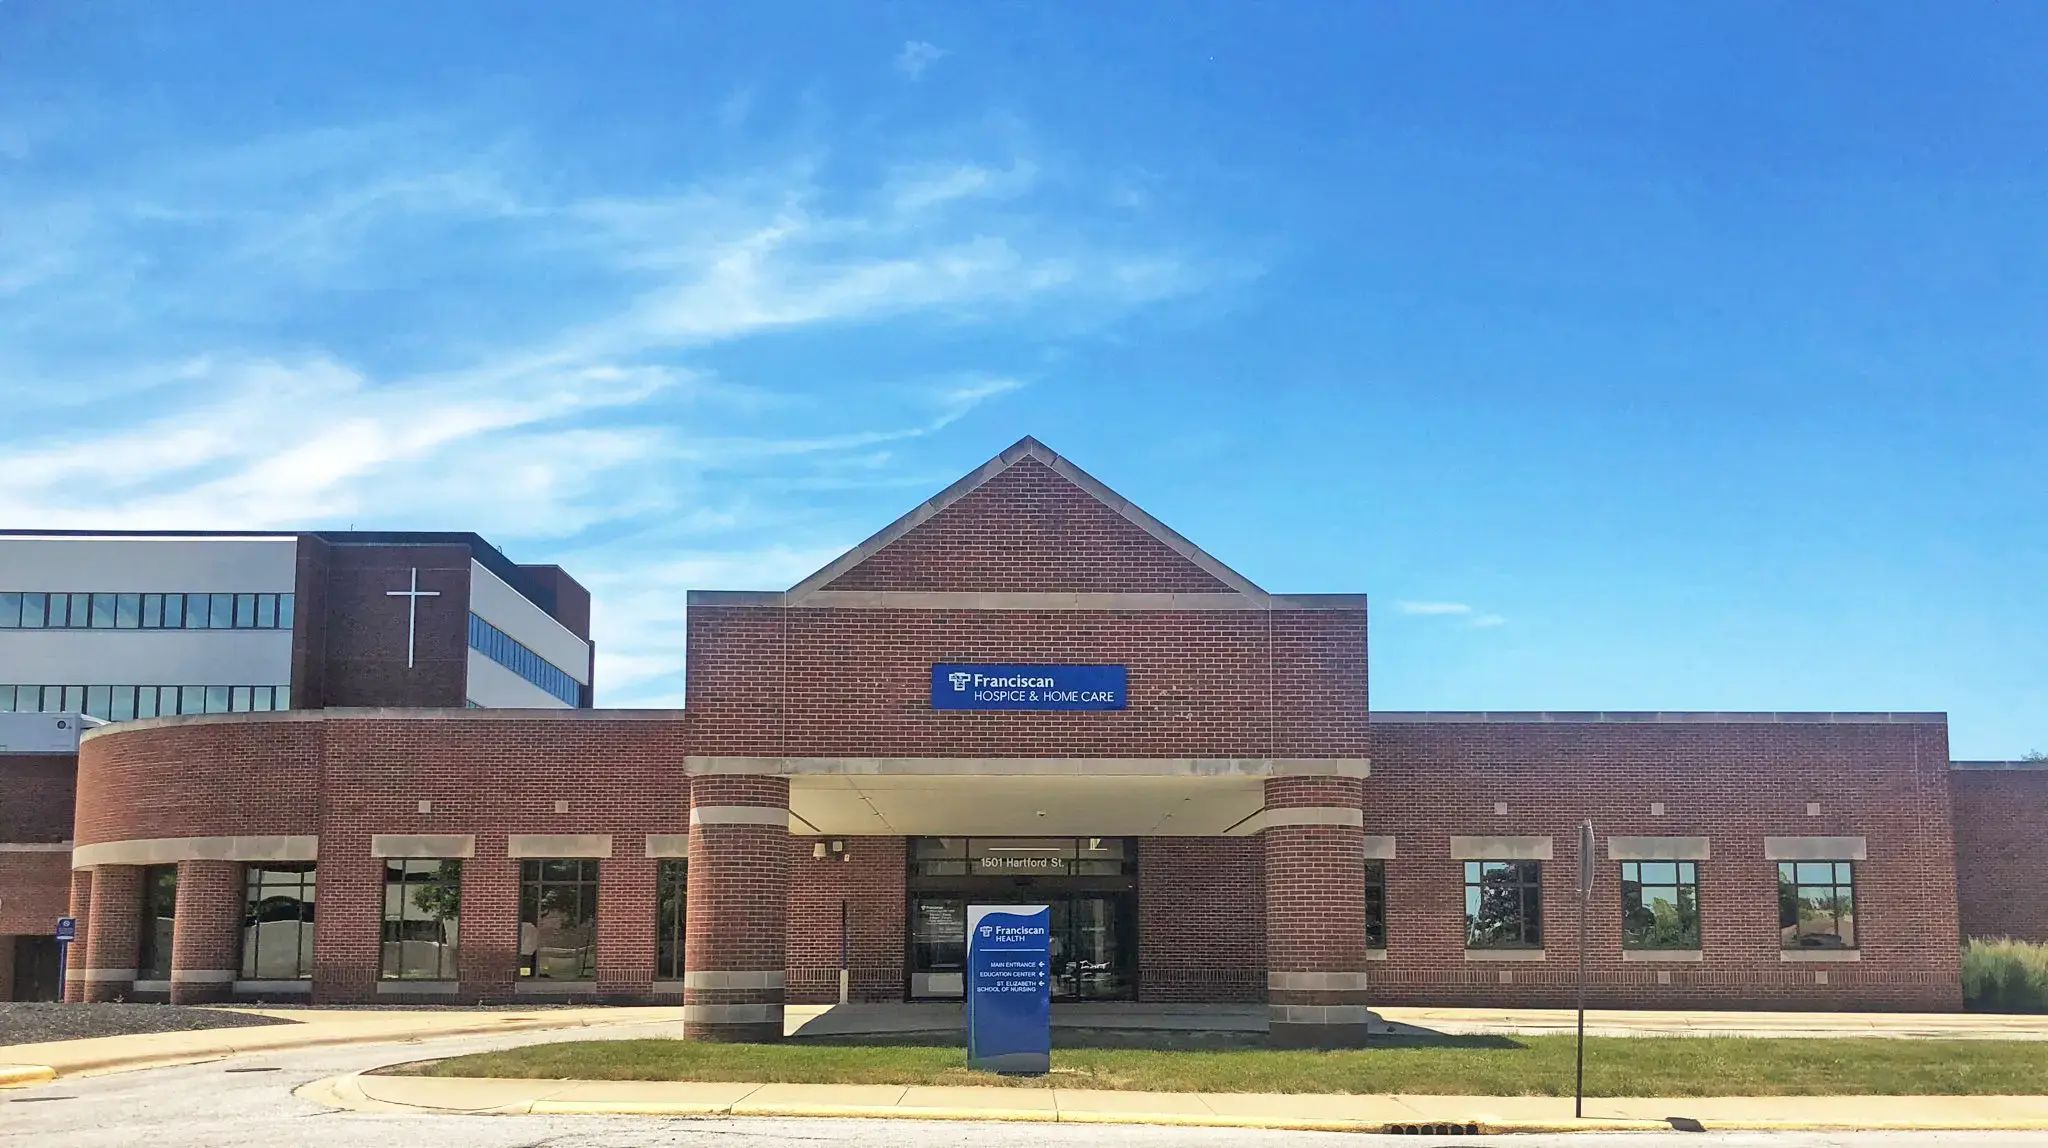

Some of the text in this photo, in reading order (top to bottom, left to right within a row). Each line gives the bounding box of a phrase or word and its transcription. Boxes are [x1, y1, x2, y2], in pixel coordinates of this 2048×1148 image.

[974, 673, 1054, 688] Franciscan
[974, 691, 1115, 702] HOSPICE & HOME CARE
[981, 857, 1065, 868] 1501 Hartford St.
[995, 926, 1045, 935] Franciscan
